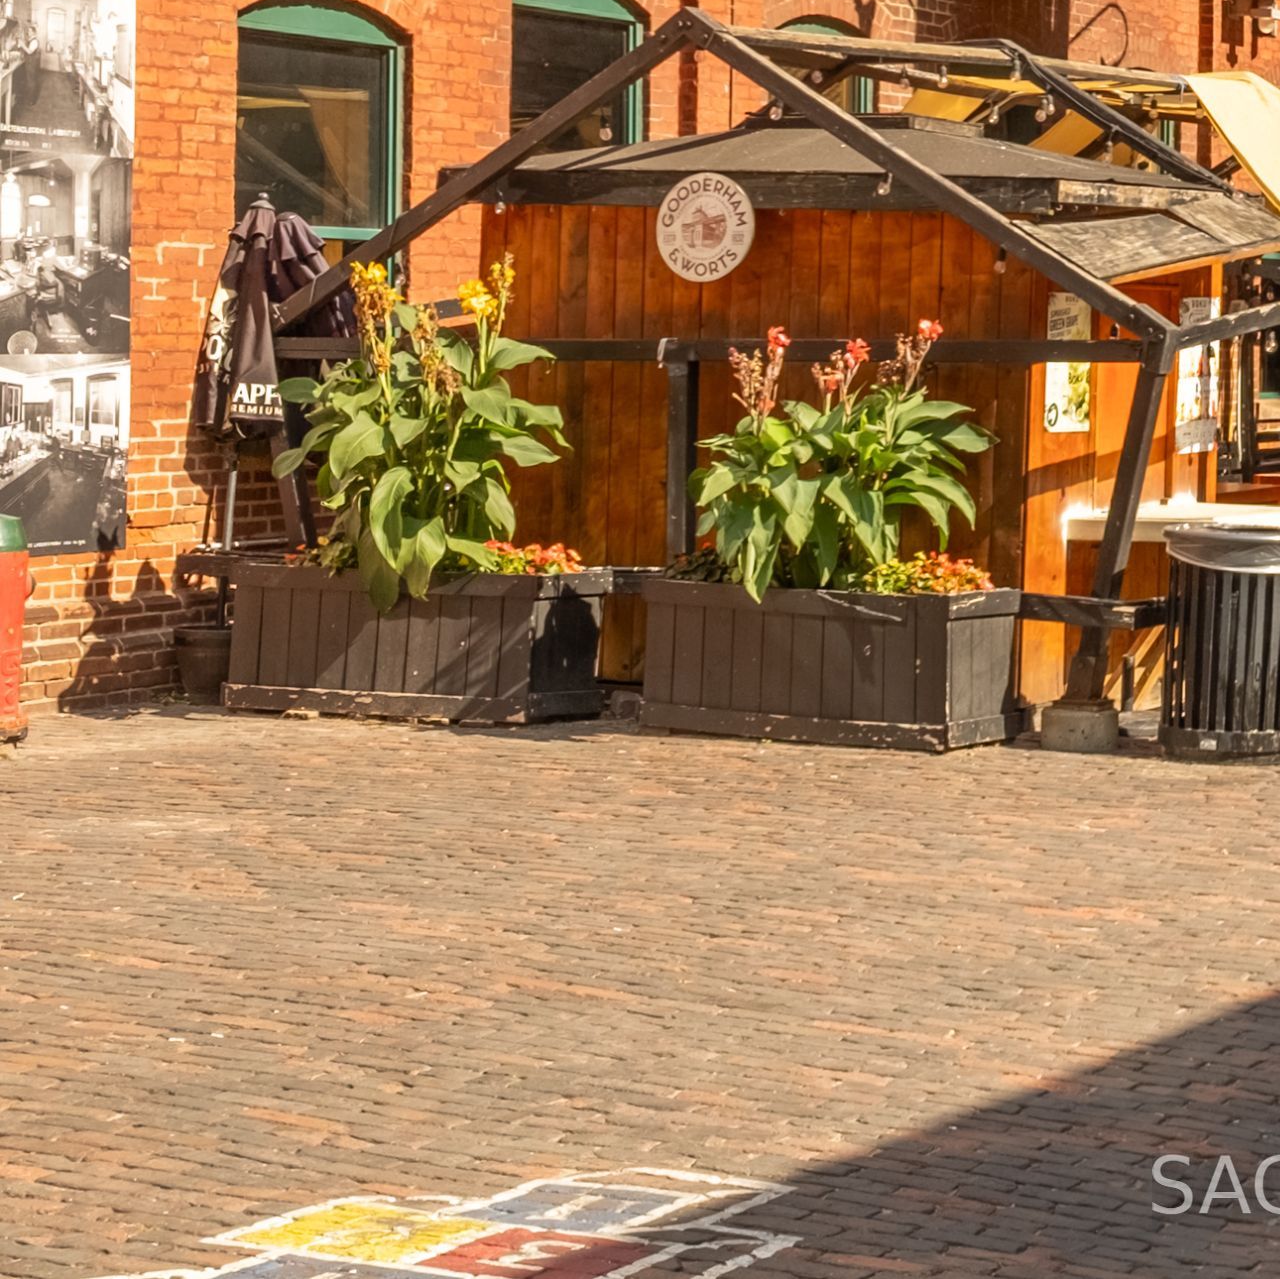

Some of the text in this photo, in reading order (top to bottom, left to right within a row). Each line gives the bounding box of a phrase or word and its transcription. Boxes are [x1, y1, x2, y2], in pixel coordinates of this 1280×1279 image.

[662, 178, 748, 228] GOODERHAM
[669, 248, 738, 277] & WORTS
[231, 404, 283, 416] REMIUM
